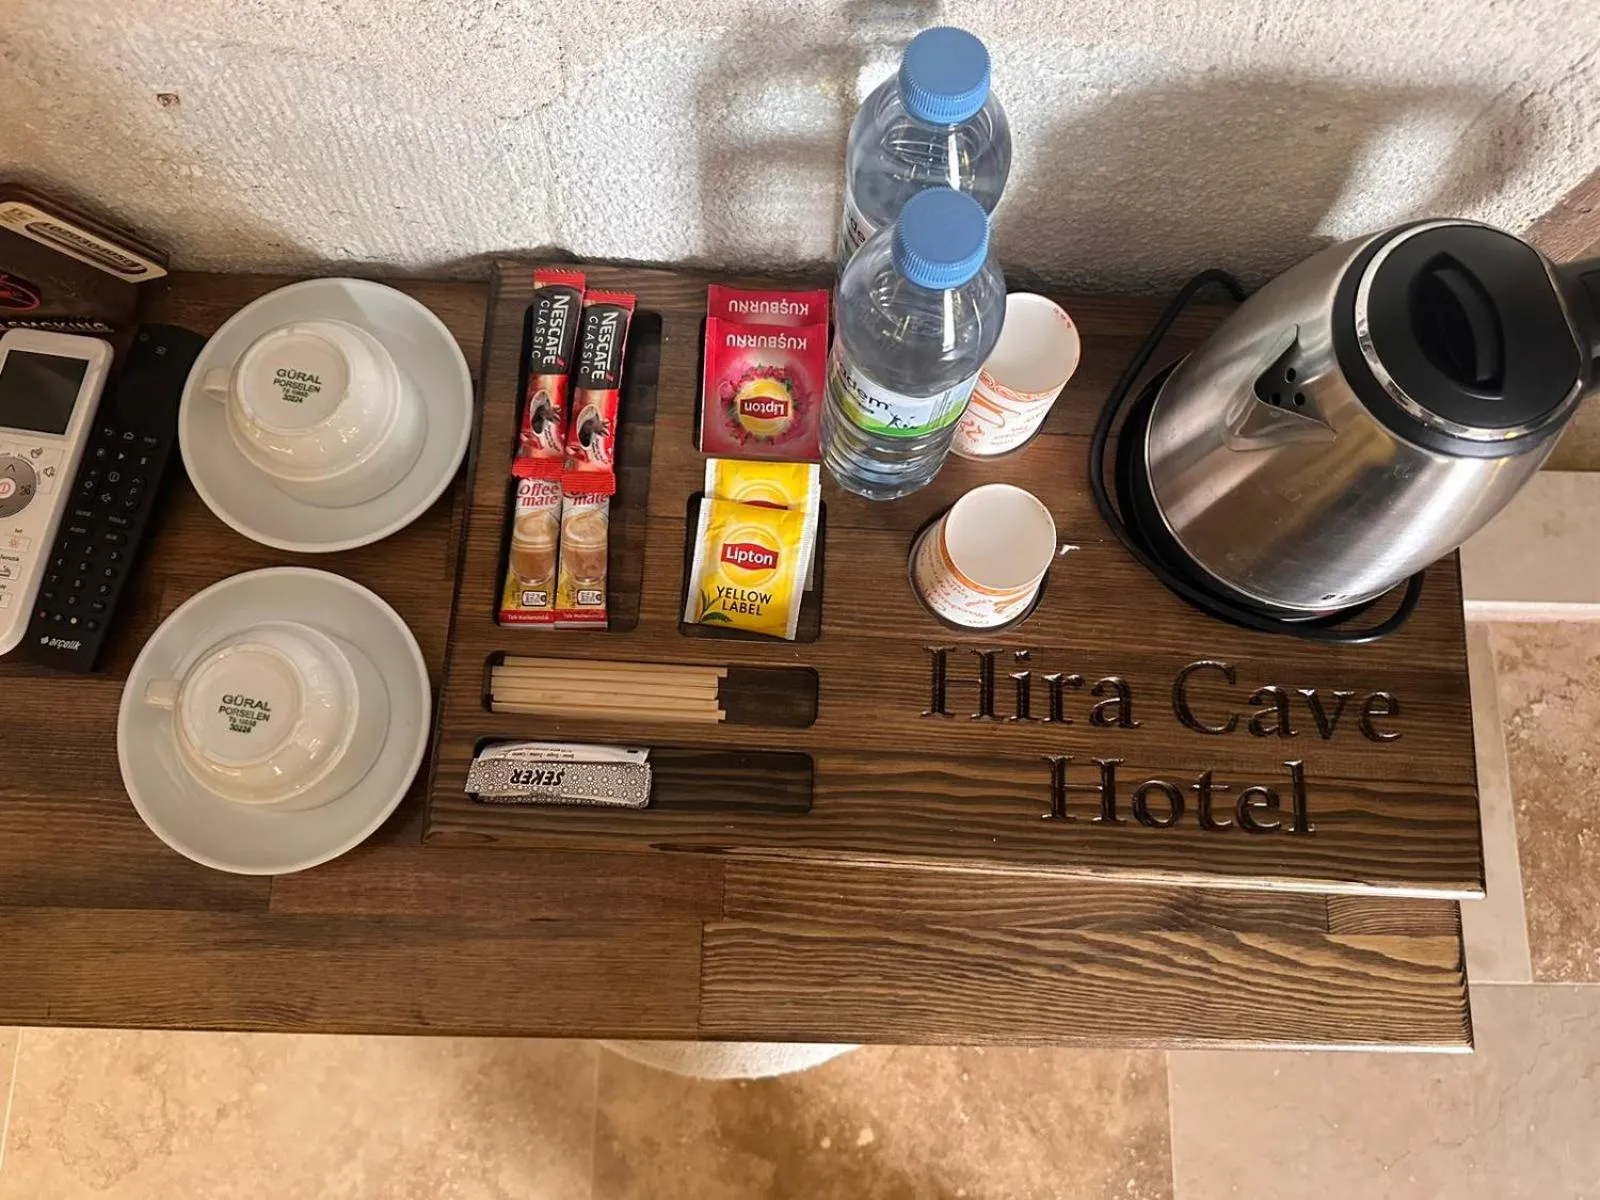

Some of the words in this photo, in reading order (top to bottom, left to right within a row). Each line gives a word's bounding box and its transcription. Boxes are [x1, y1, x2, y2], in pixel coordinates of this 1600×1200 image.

[728, 298, 808, 316] KUŞBURNU
[531, 300, 550, 359] CLASSIC
[580, 315, 599, 375] CLASSIC
[726, 333, 807, 350] KUŞBURNU
[273, 377, 321, 393] PORSELEN
[276, 368, 322, 385] GÜRAL
[744, 402, 785, 416] Lipton
[520, 482, 560, 497] offee
[725, 546, 773, 567] Lipton
[717, 586, 773, 605] YELLOW
[721, 600, 763, 616] LABEL
[222, 694, 272, 712] GÜRAL
[921, 645, 1142, 730] Hira
[1171, 659, 1403, 743] Cave
[218, 705, 271, 722] PORSELEN
[510, 768, 566, 787] ŞEKER
[1040, 754, 1318, 836] Hotel
